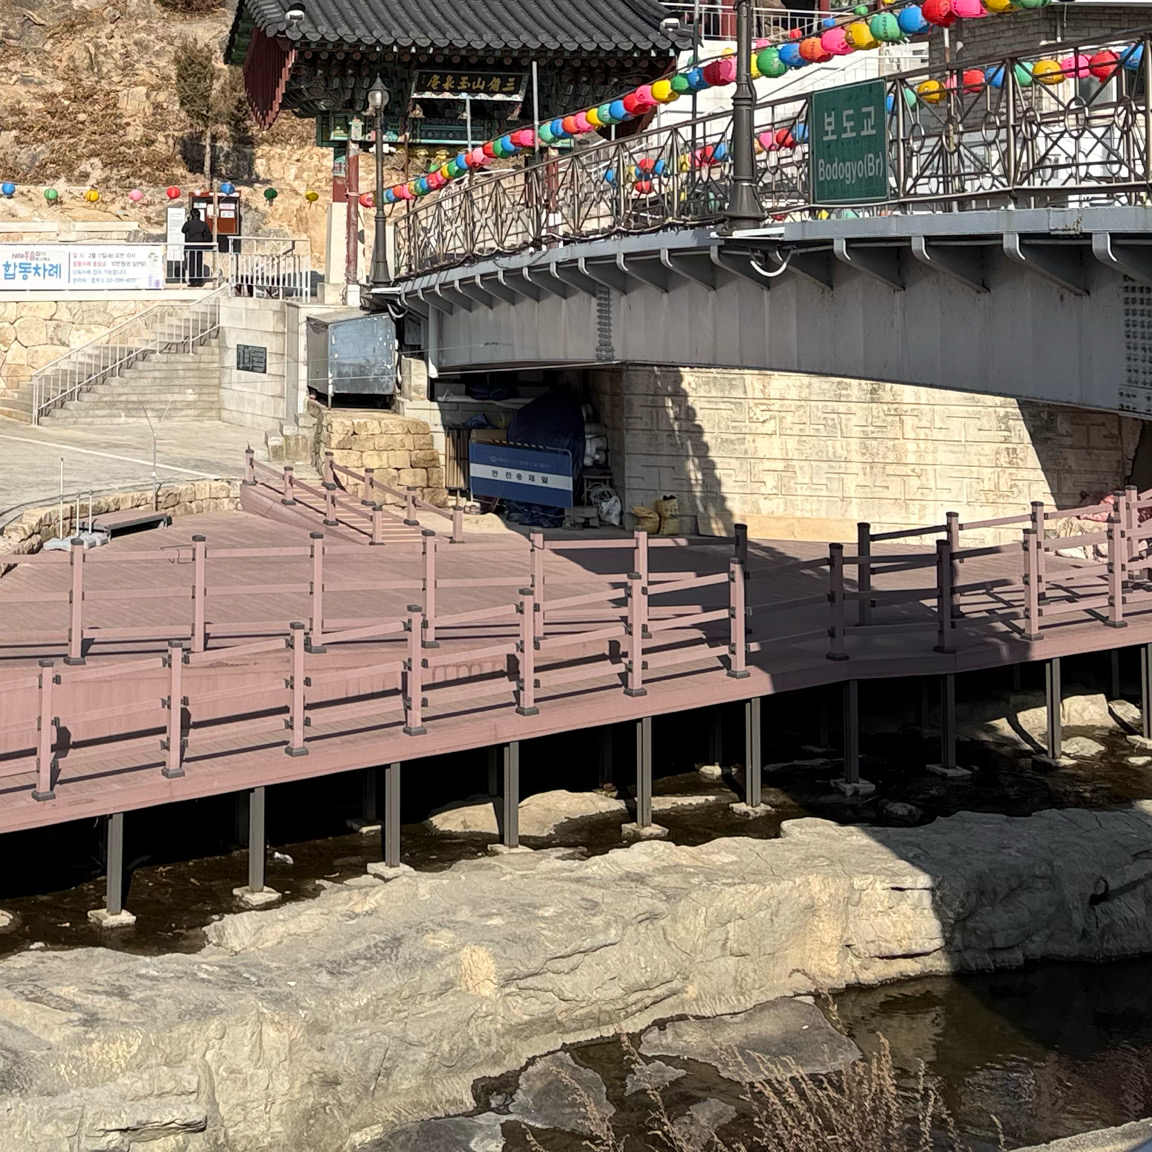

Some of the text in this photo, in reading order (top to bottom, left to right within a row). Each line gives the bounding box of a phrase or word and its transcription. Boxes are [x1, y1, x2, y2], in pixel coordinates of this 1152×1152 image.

[823, 106, 877, 141] 보도교
[818, 152, 884, 184] Bodogyo(Br)
[2, 261, 62, 281] 합동차례
